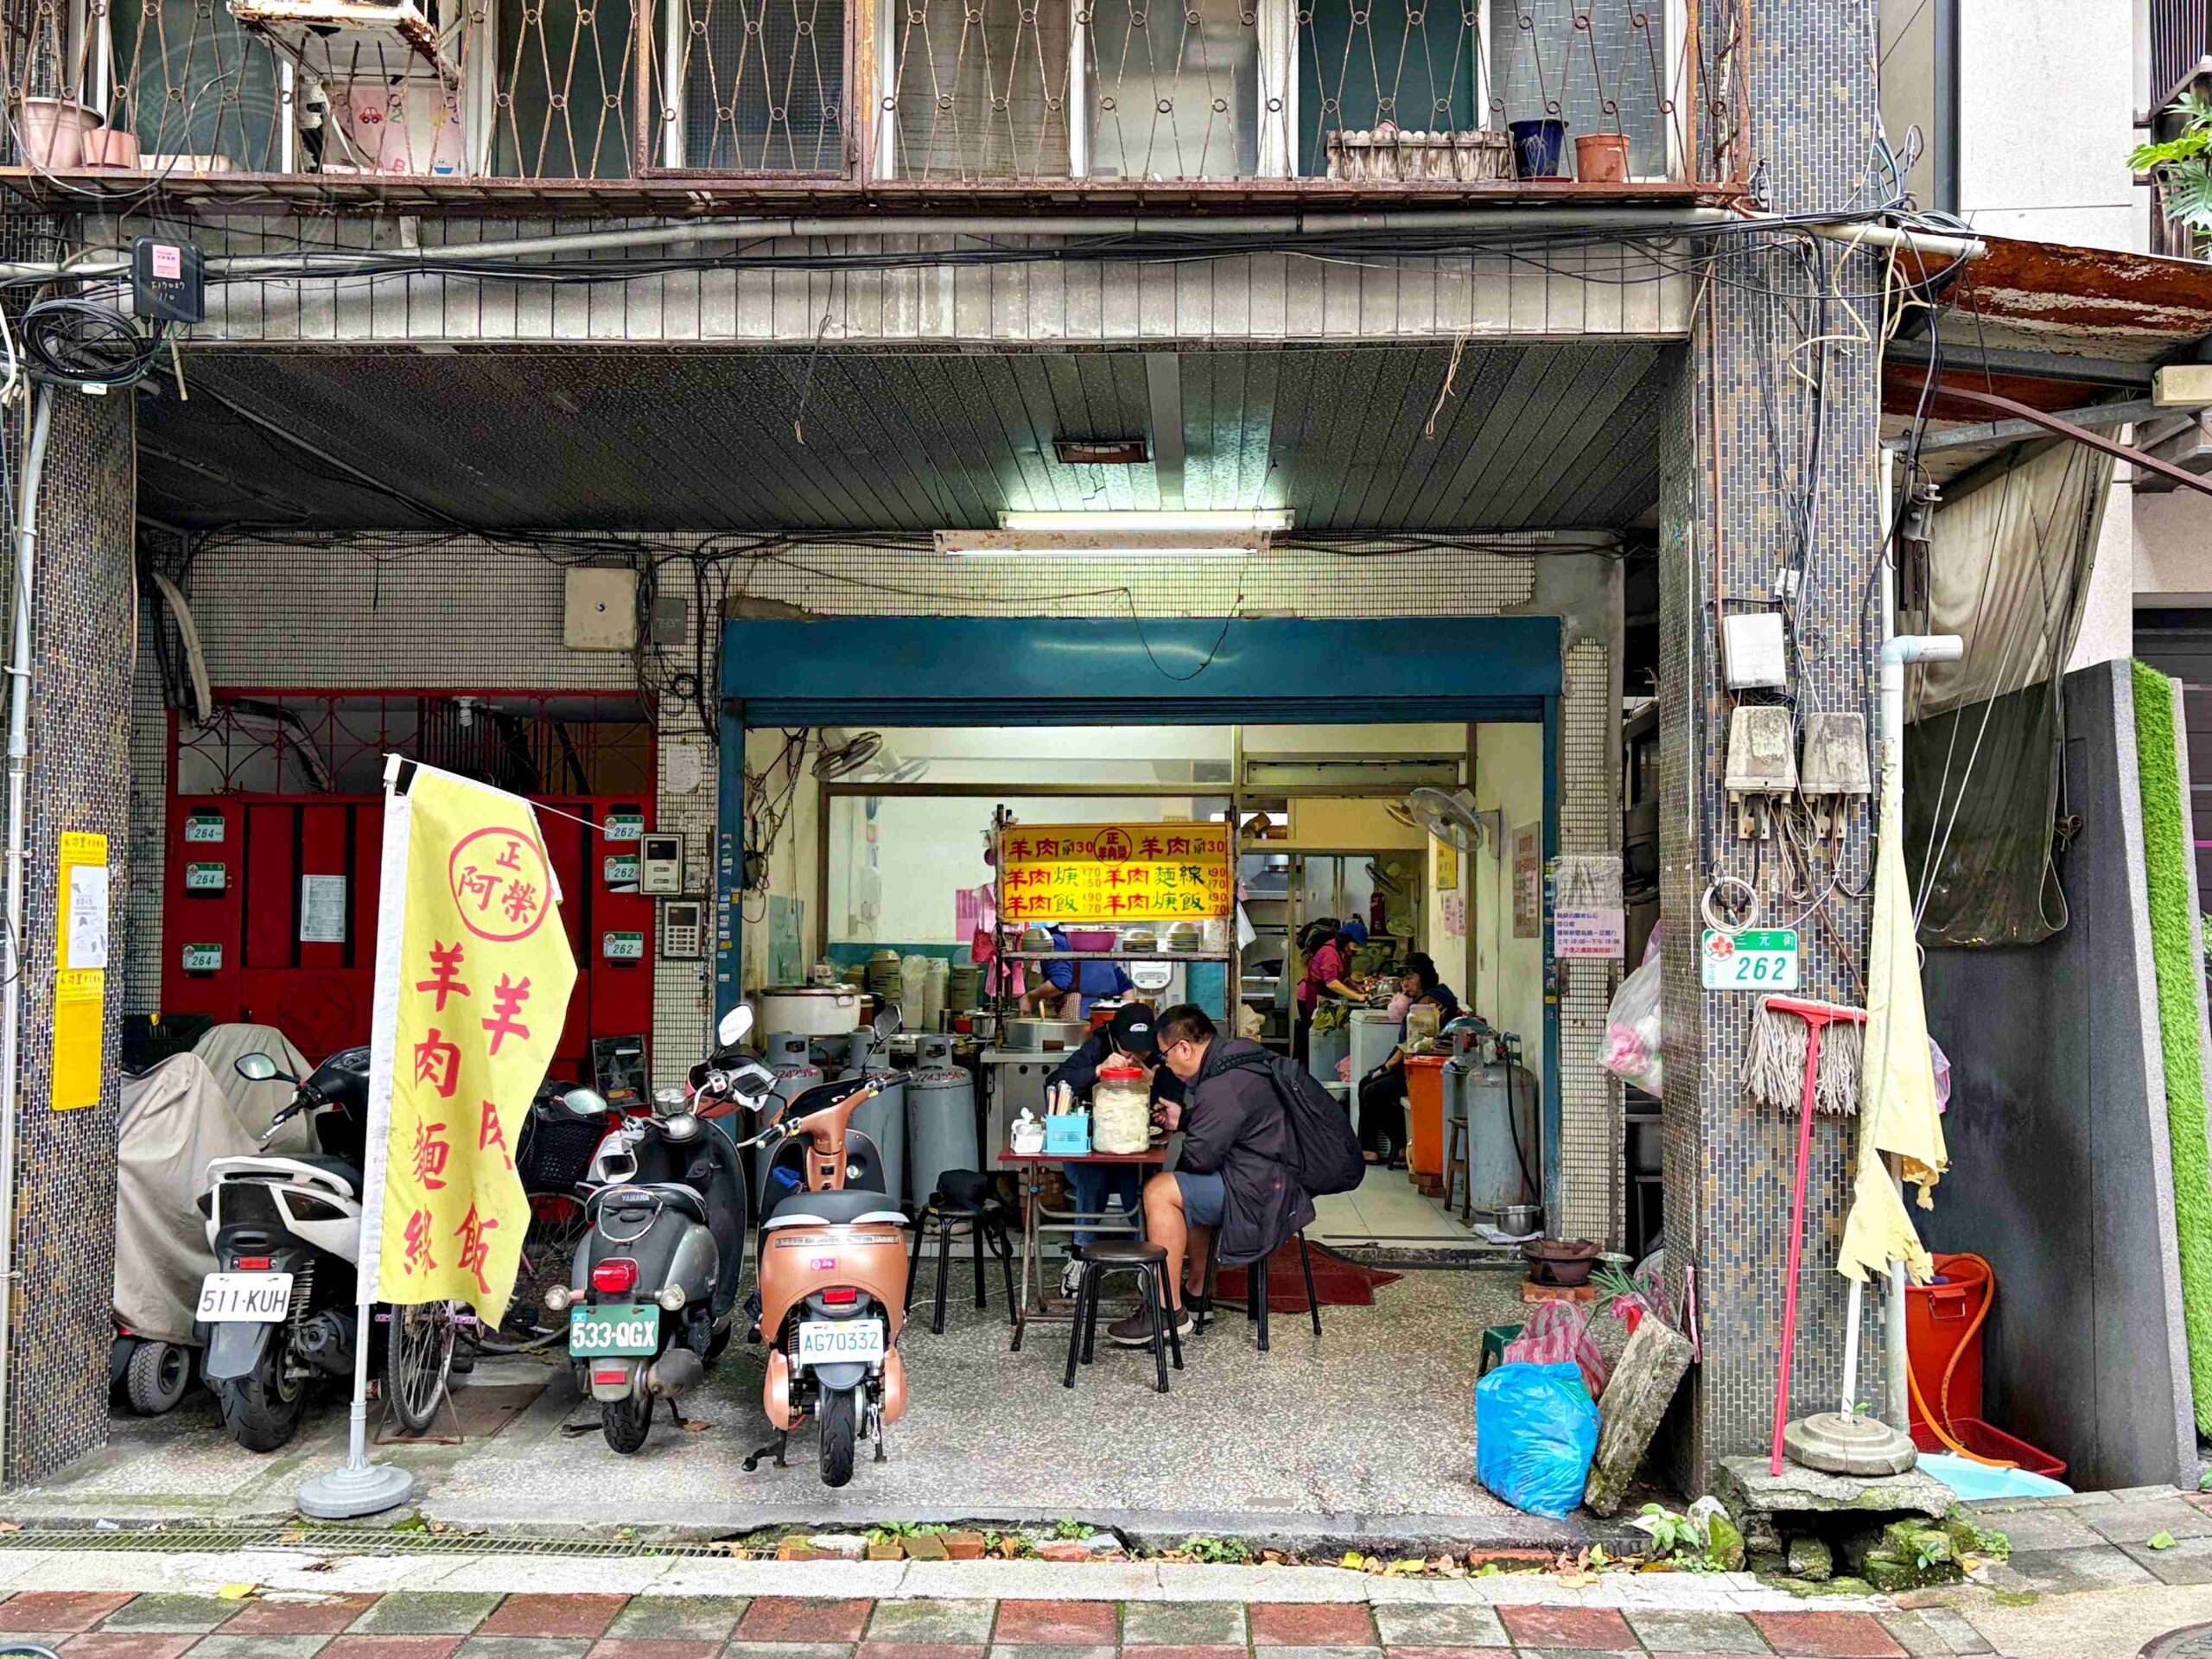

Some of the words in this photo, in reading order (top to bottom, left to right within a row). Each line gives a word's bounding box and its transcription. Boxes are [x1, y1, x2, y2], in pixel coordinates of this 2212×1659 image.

[194, 829, 214, 838] 264
[613, 827, 635, 837] 262
[1106, 832, 1119, 844] 正
[496, 841, 522, 871] 正
[1008, 838, 1059, 862] 羊肉
[1071, 842, 1094, 853] 130
[1139, 836, 1190, 861] 羊肉
[1202, 841, 1224, 852] 130
[195, 874, 215, 885] 264
[613, 868, 635, 878] 262
[1103, 865, 1205, 889] 羊肉麵線
[458, 866, 537, 924] 阿榮
[1005, 893, 1078, 918] 羊肉飯
[613, 944, 633, 954] 262
[1736, 932, 1795, 947] 三元街
[192, 956, 212, 966] 264
[1736, 957, 1786, 980] 262
[404, 939, 471, 1278] 羊肉麵線
[454, 972, 531, 1294] 羊肉飯
[622, 1193, 650, 1202] YAMAHA
[572, 1321, 656, 1348] 533-QGX
[804, 1332, 879, 1351] AG70332
